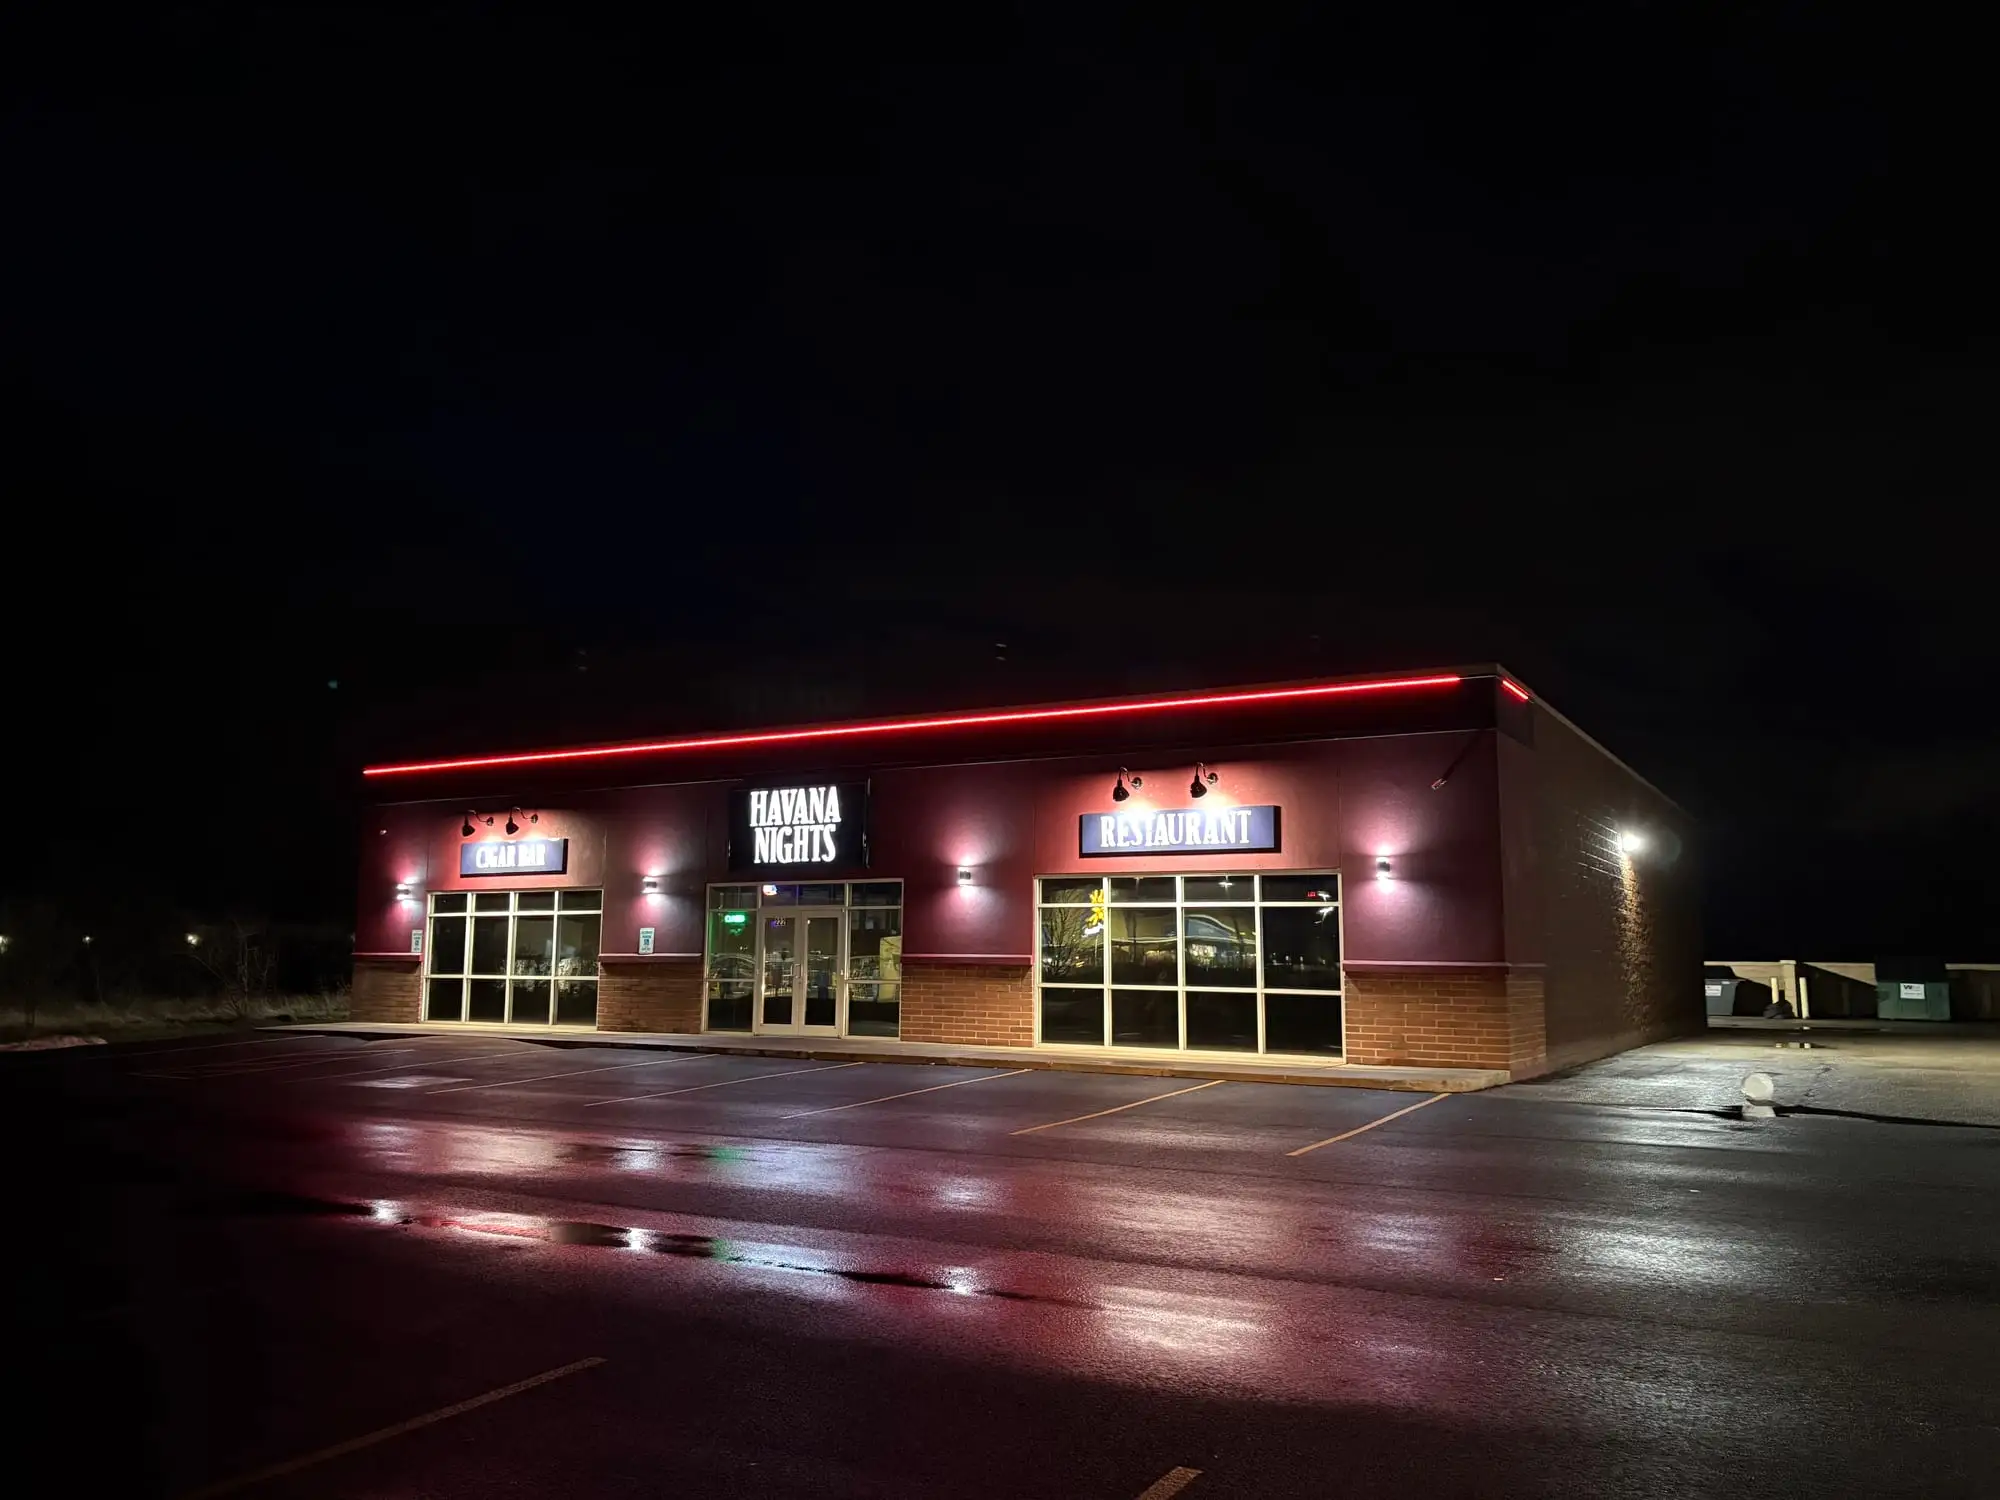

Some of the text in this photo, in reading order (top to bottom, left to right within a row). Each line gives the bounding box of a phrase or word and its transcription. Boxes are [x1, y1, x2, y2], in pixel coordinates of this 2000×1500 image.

[749, 785, 842, 827] HAVANA
[753, 823, 837, 864] NIGHTS
[1100, 810, 1252, 848] RESTAURANT
